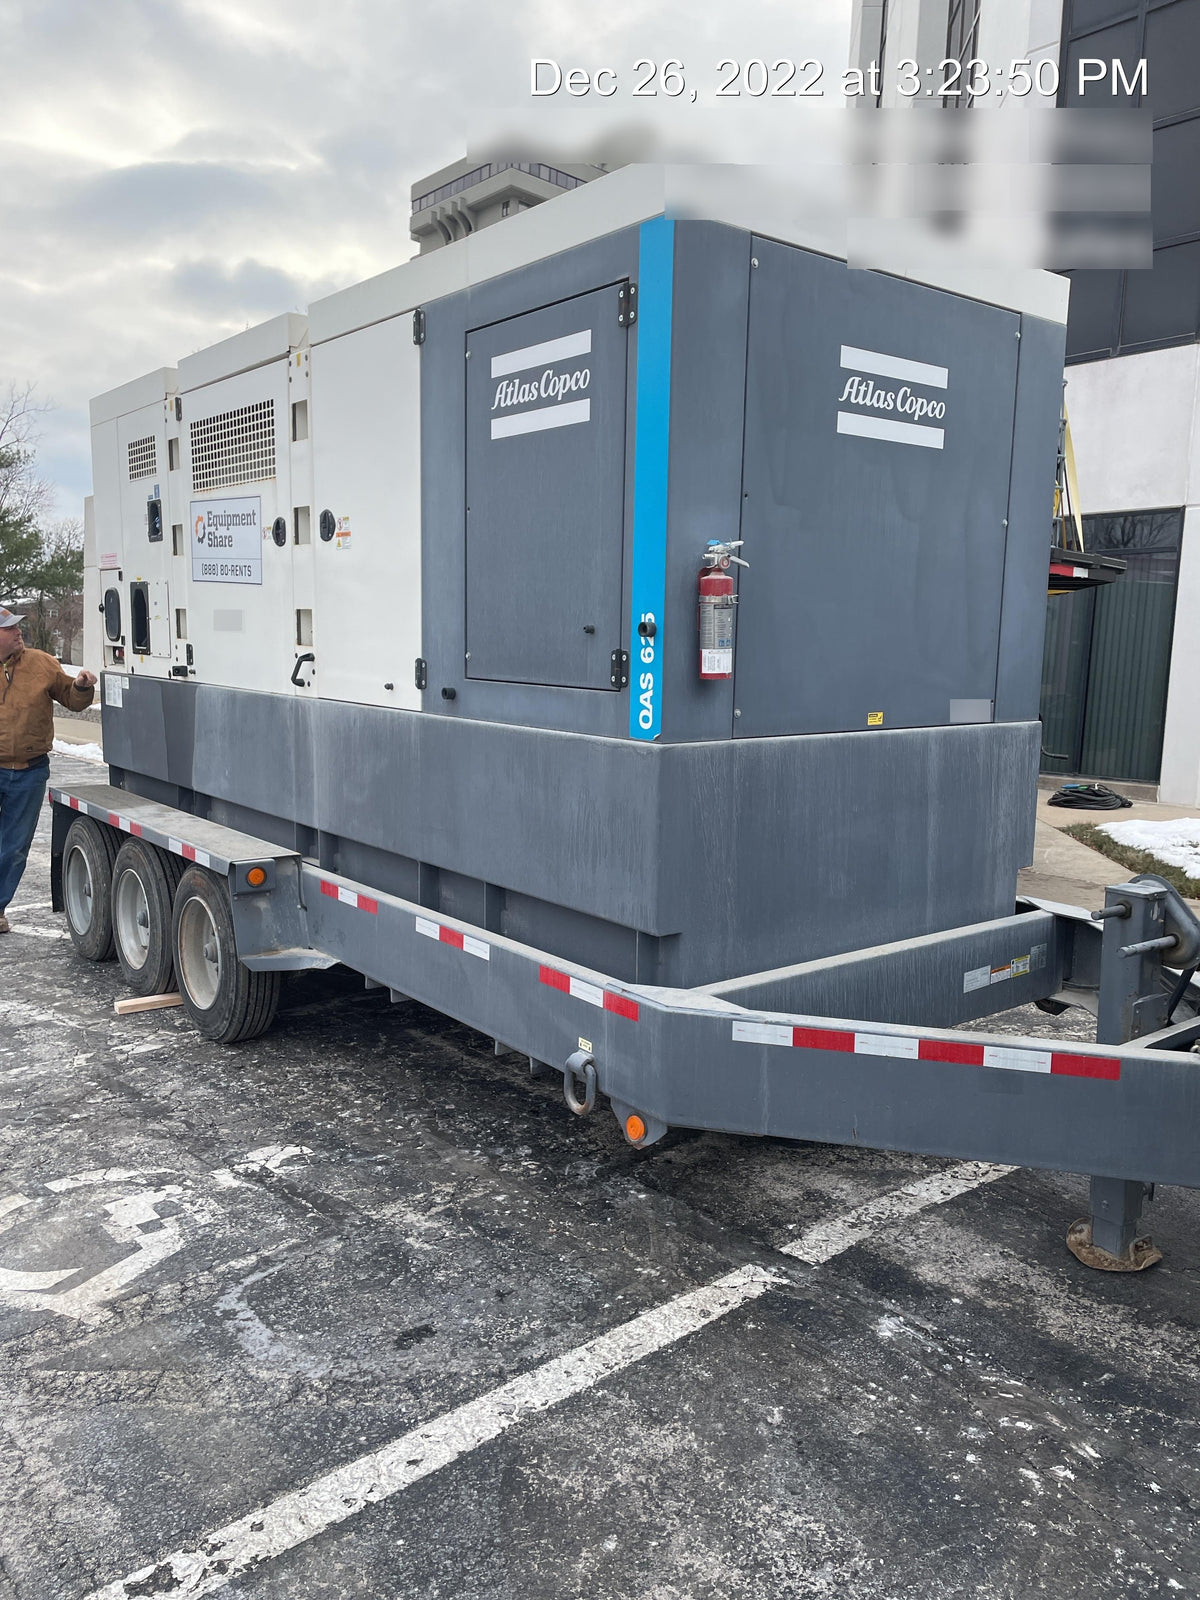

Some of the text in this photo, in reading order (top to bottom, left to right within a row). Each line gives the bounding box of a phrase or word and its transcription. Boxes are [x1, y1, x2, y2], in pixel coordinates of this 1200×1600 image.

[491, 368, 590, 410] Atlas Copco
[838, 376, 946, 421] Atlas Copco
[207, 509, 256, 530] Equipment
[207, 531, 233, 548] Share
[201, 563, 252, 577] (888) 80-RENTS
[639, 672, 654, 730] QAS
